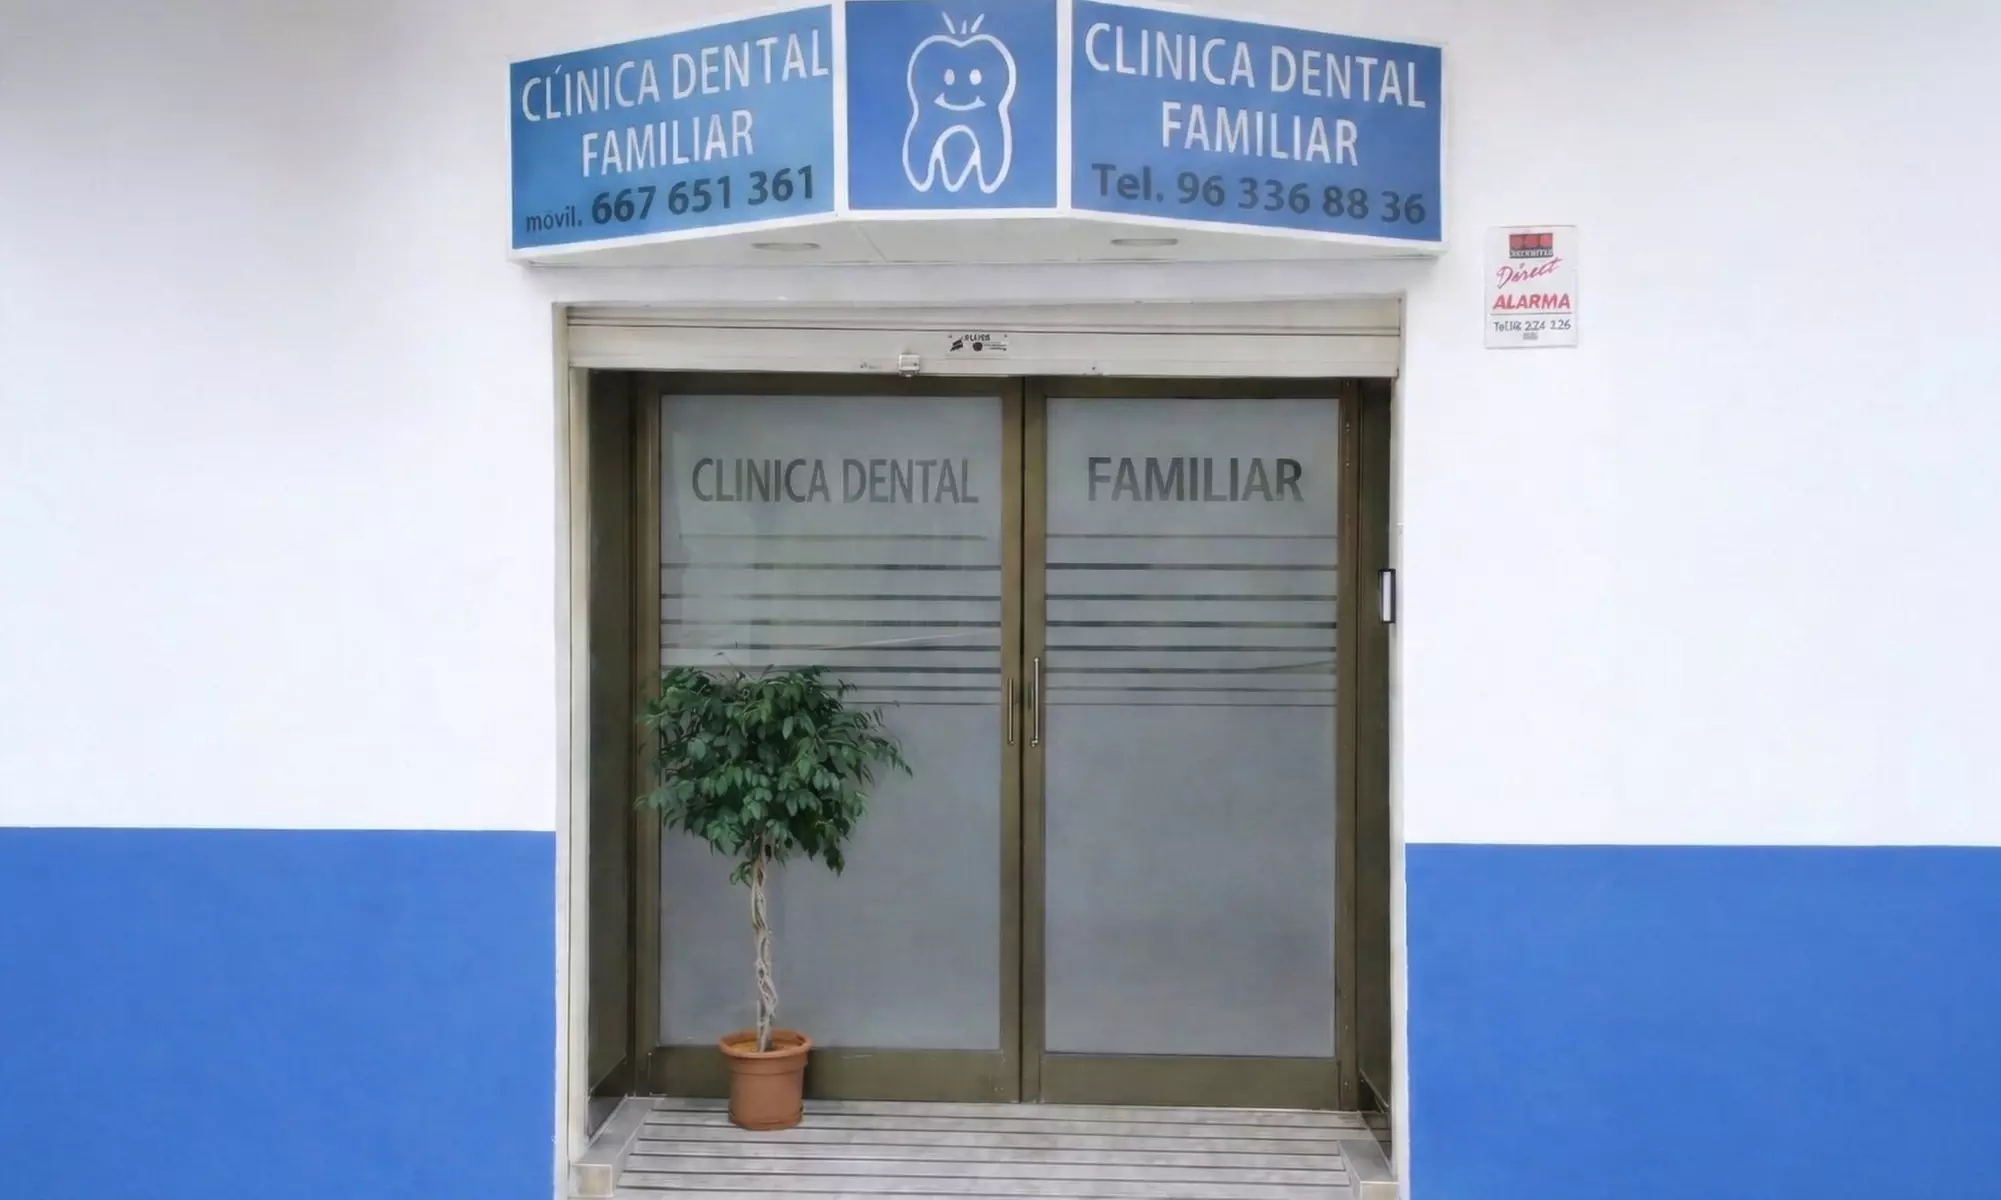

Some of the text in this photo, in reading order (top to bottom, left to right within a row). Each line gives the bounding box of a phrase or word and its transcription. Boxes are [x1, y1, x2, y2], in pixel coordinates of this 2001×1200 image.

[673, 29, 828, 99] DENTAL
[1085, 22, 1426, 108] CLINICA DENTAL
[582, 109, 754, 177] FAMILIAR
[1162, 101, 1358, 166] FAMILIAR
[592, 185, 656, 224] 667
[668, 175, 731, 215] 651
[748, 164, 813, 205] 361
[1092, 163, 1426, 225] Tel. 96 336 88 36
[1492, 293, 1570, 310] ALARMA
[692, 456, 1305, 504] CLINICA DENTAL FAMILIAR
